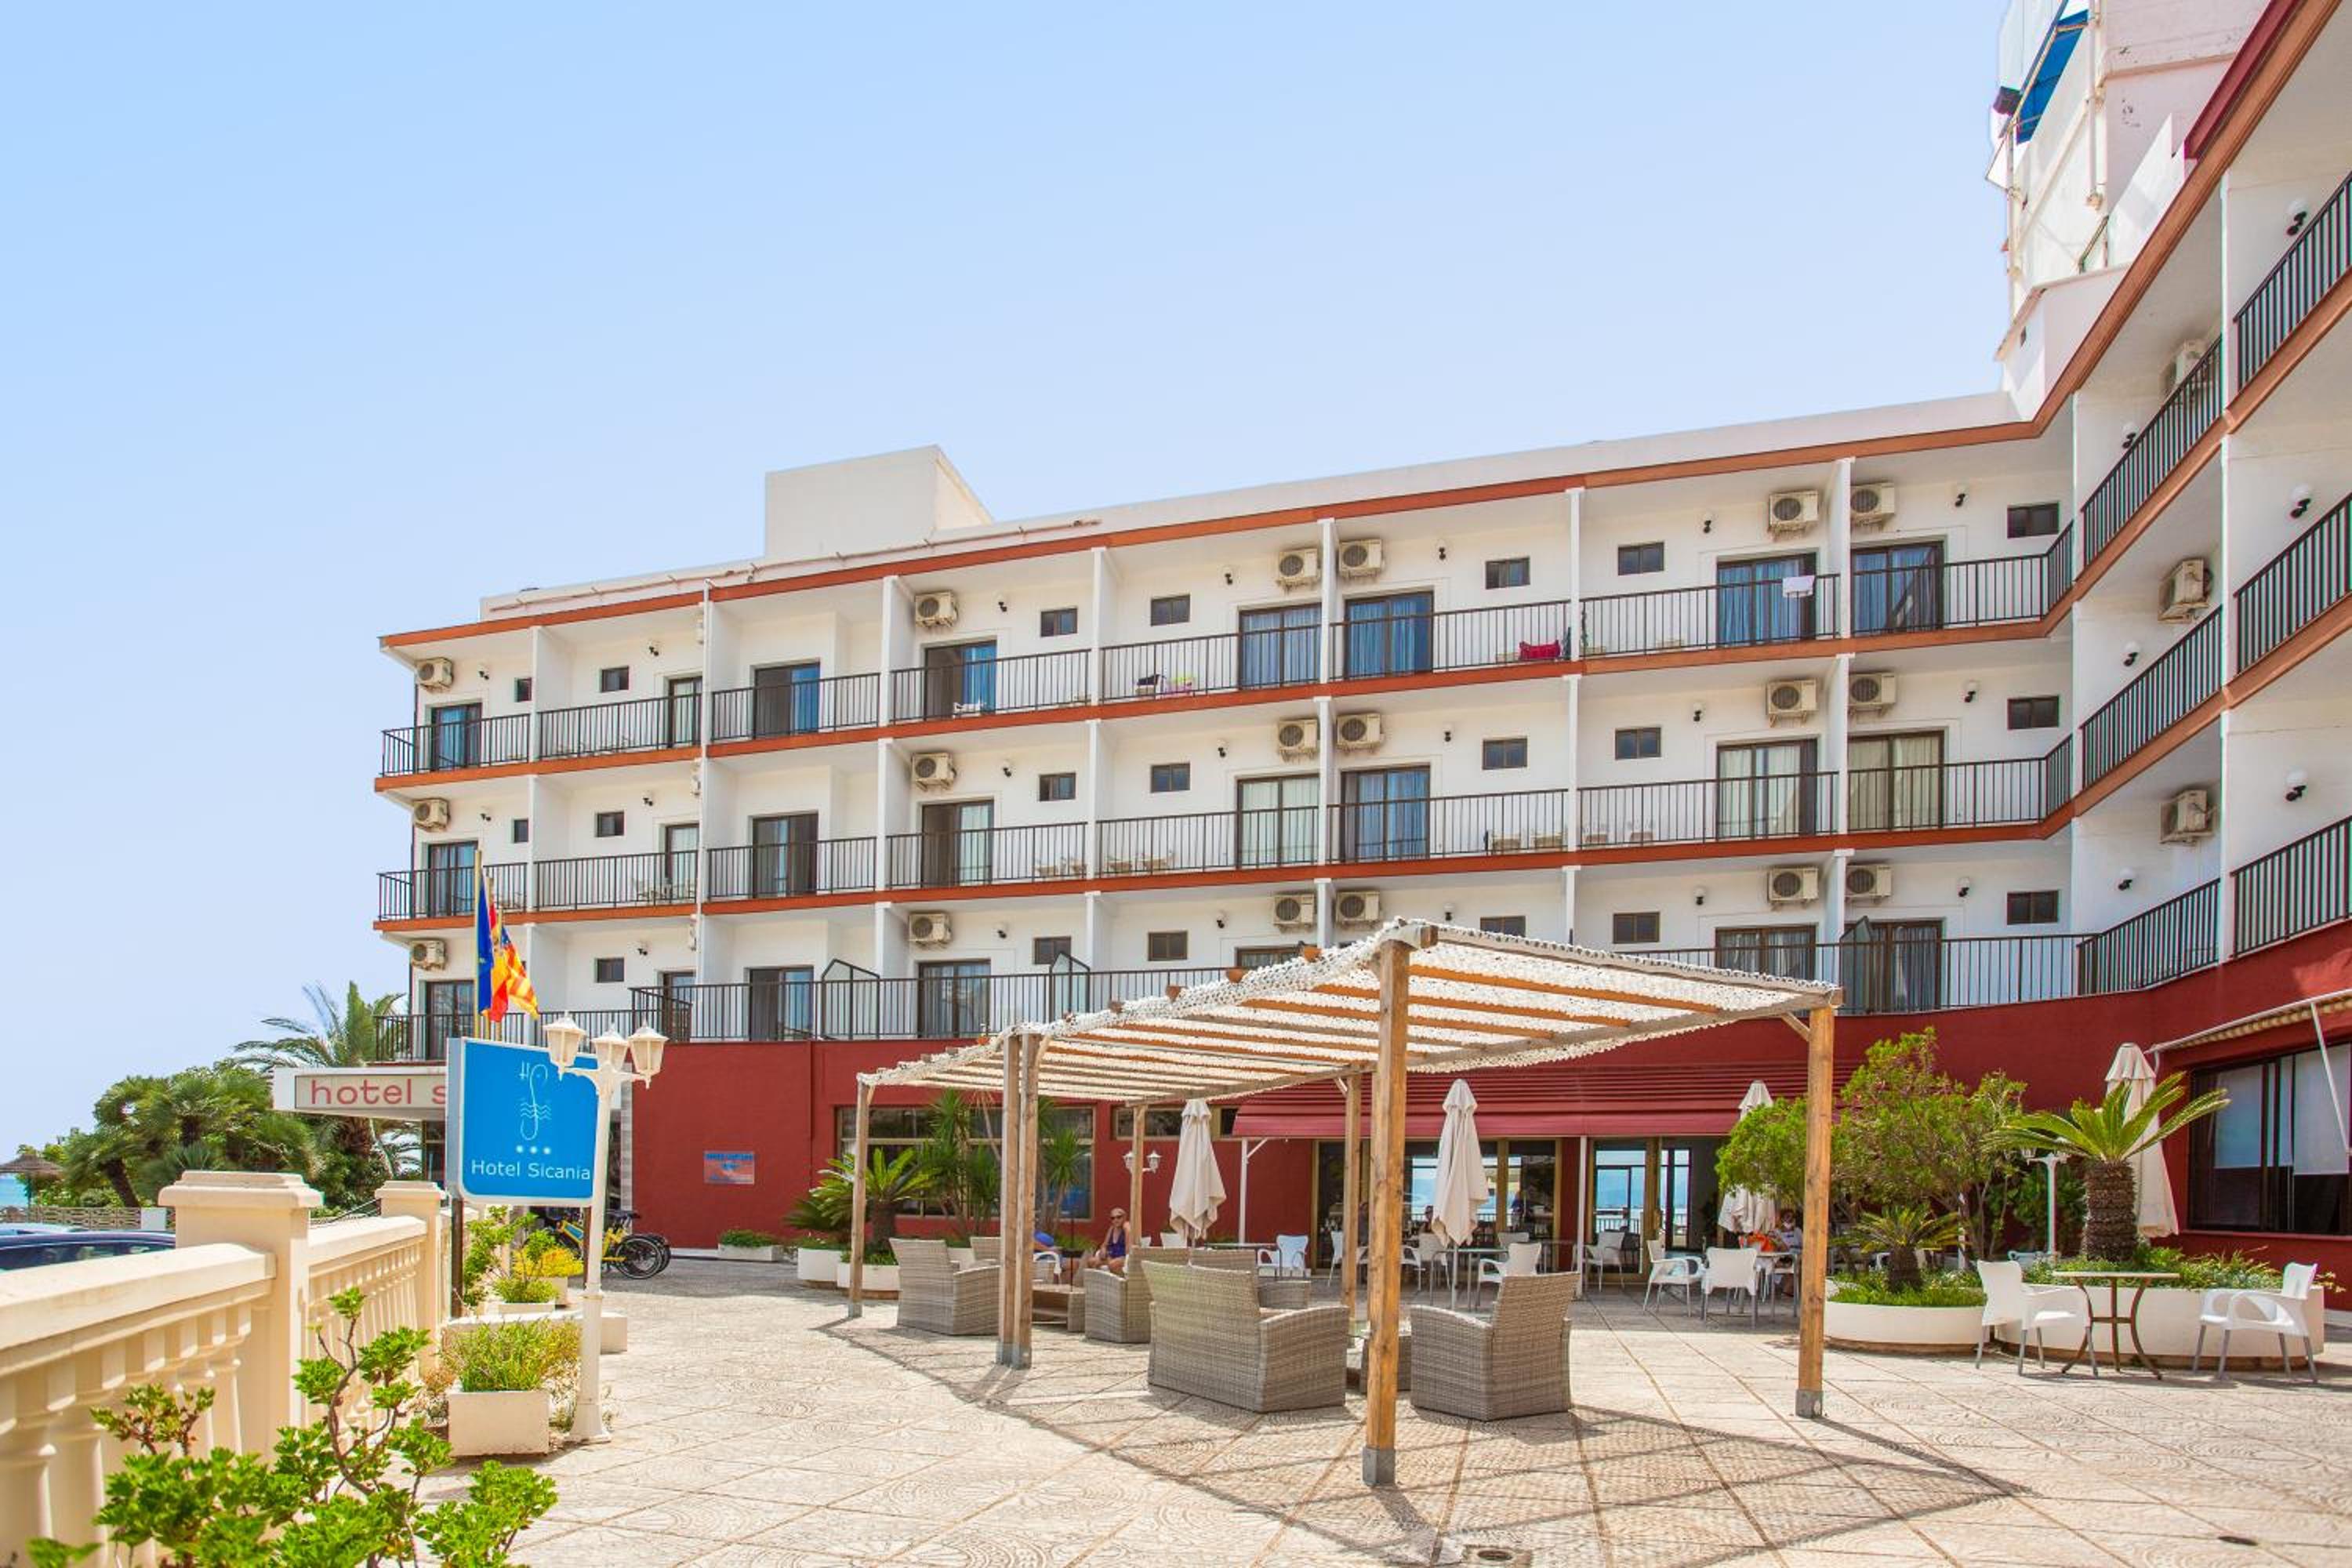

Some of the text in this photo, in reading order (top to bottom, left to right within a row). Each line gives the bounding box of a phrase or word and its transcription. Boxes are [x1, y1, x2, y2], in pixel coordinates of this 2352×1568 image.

[311, 1078, 412, 1105] hotel
[471, 1160, 590, 1180] Hotel Sicania
